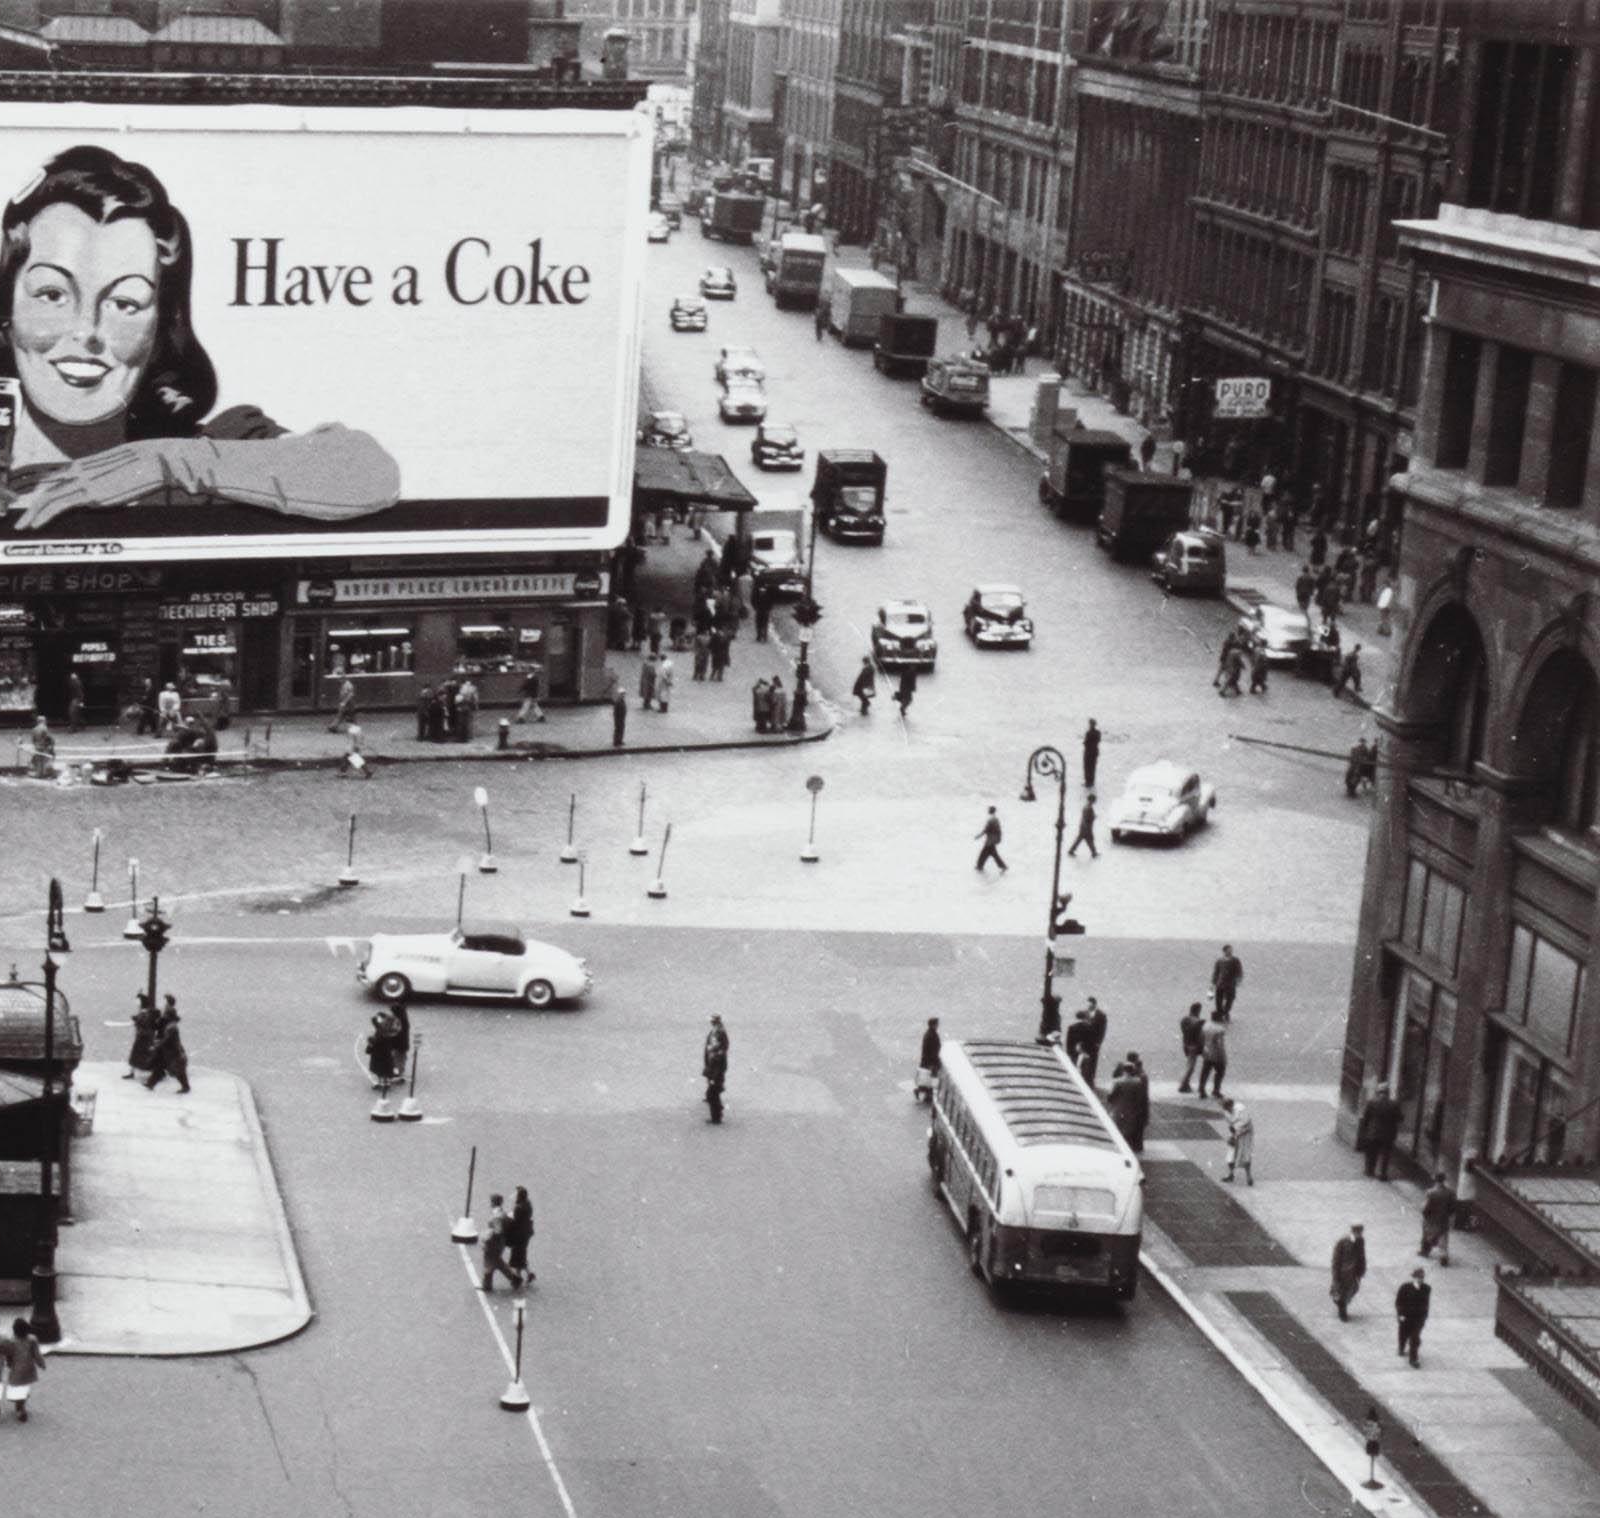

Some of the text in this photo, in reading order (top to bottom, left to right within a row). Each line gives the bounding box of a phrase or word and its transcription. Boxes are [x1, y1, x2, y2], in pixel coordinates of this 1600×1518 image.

[229, 236, 590, 306] Have a Coke
[65, 572, 132, 590] SHOP
[342, 581, 391, 597] ASTOR
[398, 579, 446, 596] PLACE
[190, 592, 245, 602] ASTOR
[242, 601, 279, 617] SHOP
[194, 635, 228, 647] TIES
